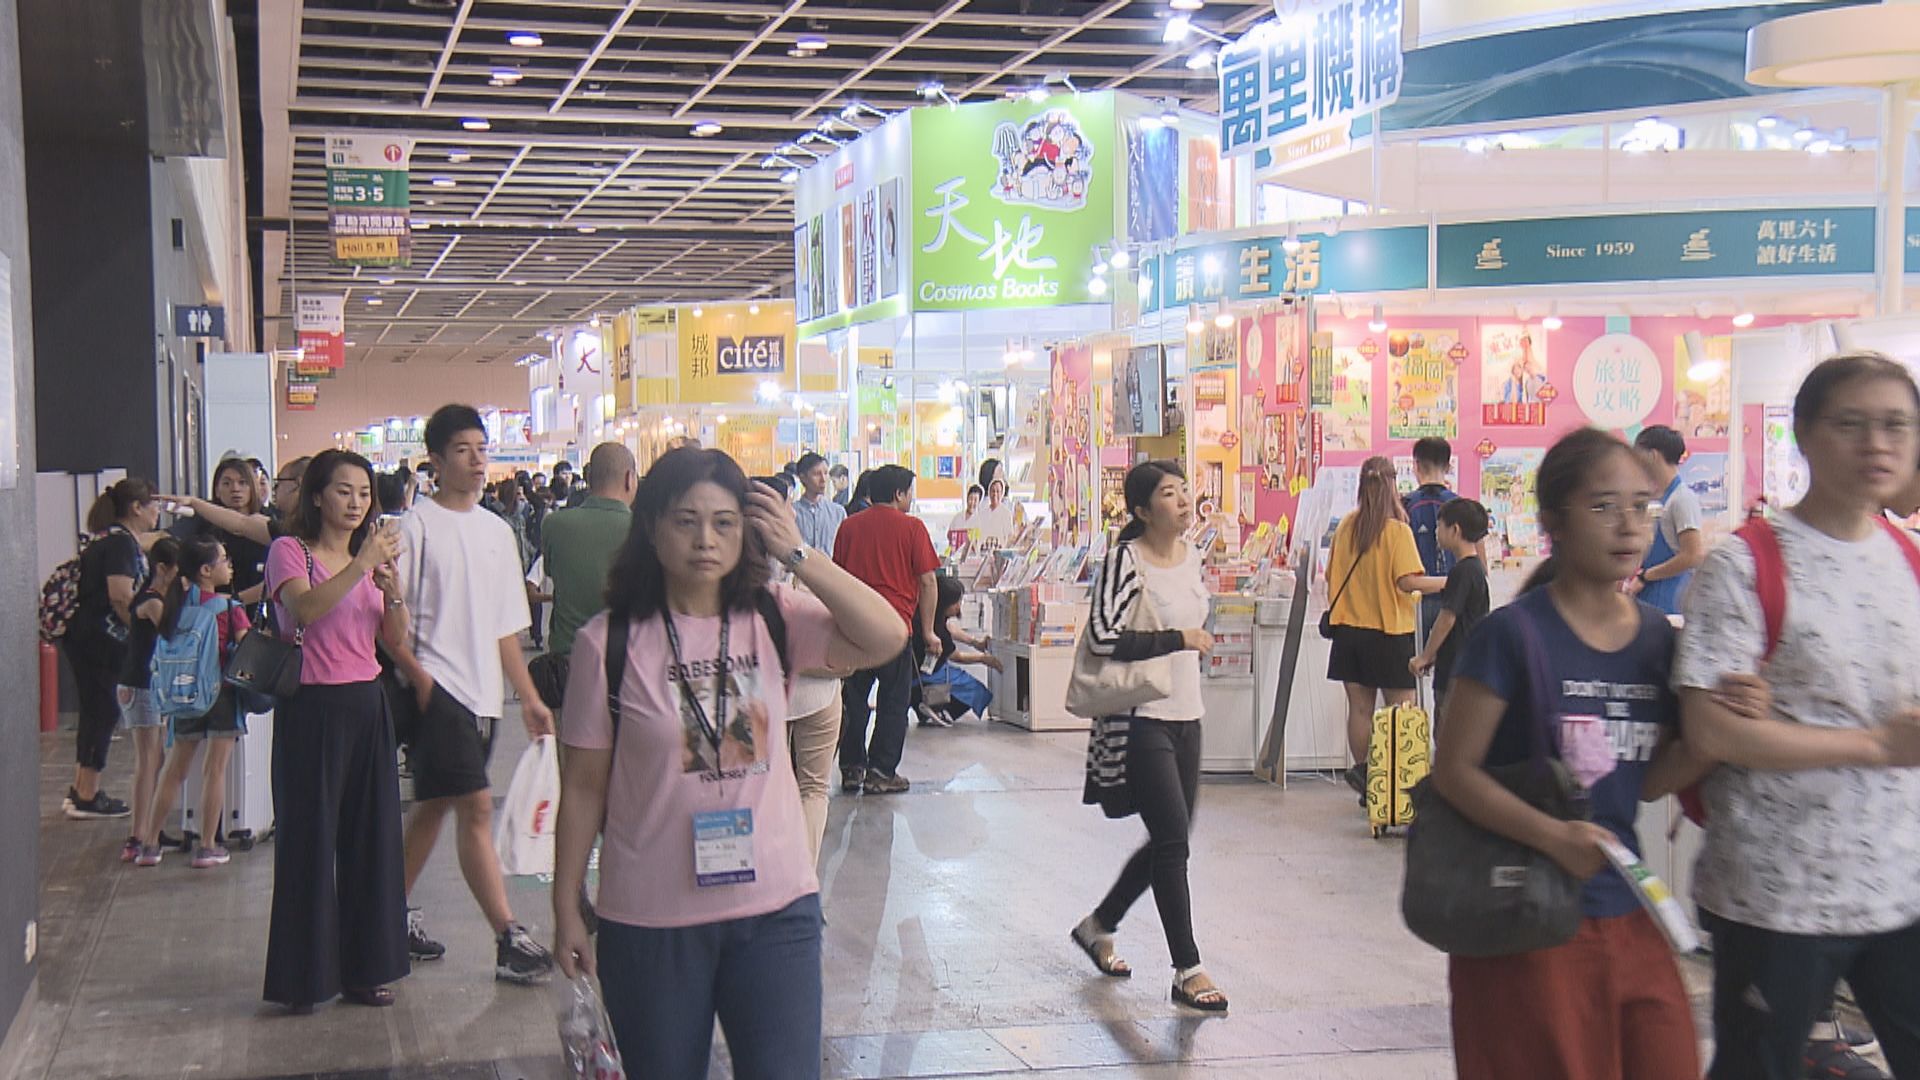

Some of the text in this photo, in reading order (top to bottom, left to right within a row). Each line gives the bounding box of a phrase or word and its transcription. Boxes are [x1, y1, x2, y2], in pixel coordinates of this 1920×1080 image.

[1222, 0, 1399, 152] 萬里機構
[1311, 133, 1331, 153] 1959
[922, 175, 1058, 280] 天地
[1757, 218, 1839, 241] 萬里六十
[1546, 241, 1636, 259] Since 1959
[1757, 242, 1839, 266] 讀好生活
[919, 276, 1059, 306] Cosmos Books
[691, 333, 709, 379] 城邦
[719, 340, 769, 369] cité
[1594, 384, 1642, 410] 攻略
